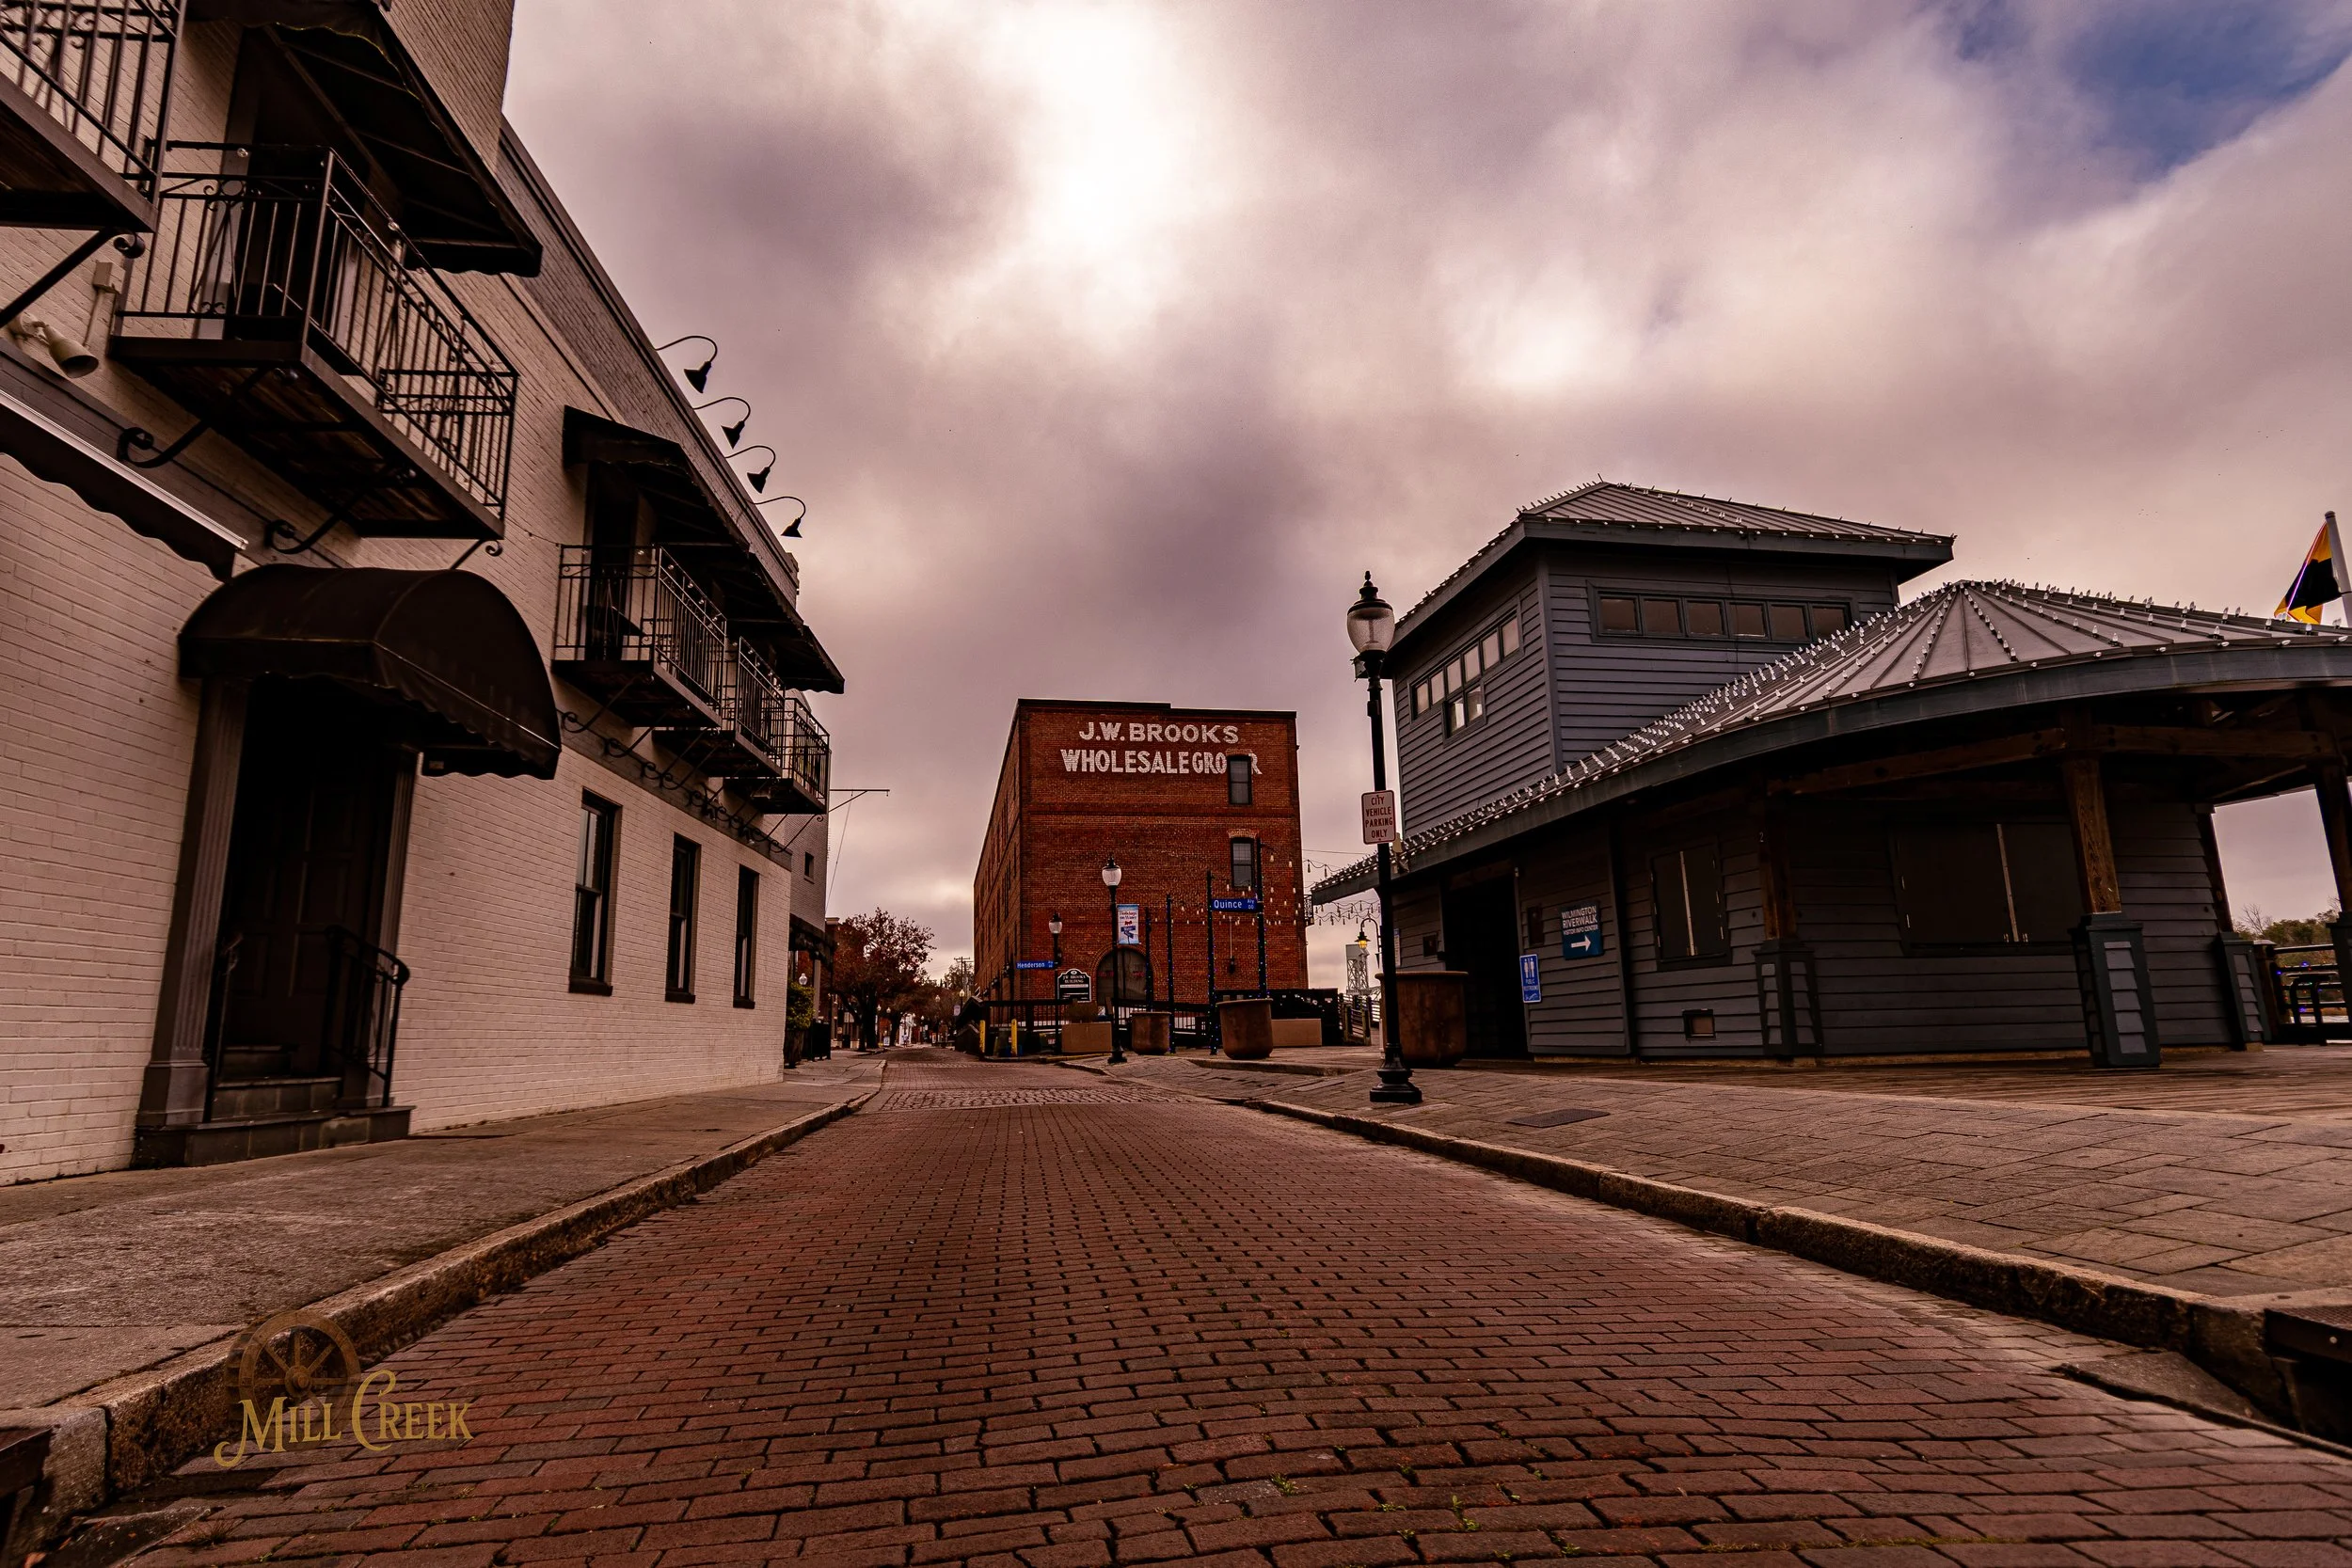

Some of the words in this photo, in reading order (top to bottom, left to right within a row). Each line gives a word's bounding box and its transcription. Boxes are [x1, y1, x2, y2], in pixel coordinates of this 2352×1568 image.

[1128, 722, 1240, 743] BROOKS
[1059, 748, 1190, 774] WHOLESALE
[1371, 796, 1385, 805] CITY
[1366, 806, 1391, 816] VEHICLE
[1365, 817, 1393, 828] PARKING
[1371, 829, 1388, 838] ONLY
[1214, 899, 1243, 909] Quince
[1561, 906, 1597, 919] WILMINGTON
[1563, 914, 1597, 928] RIVERWALK
